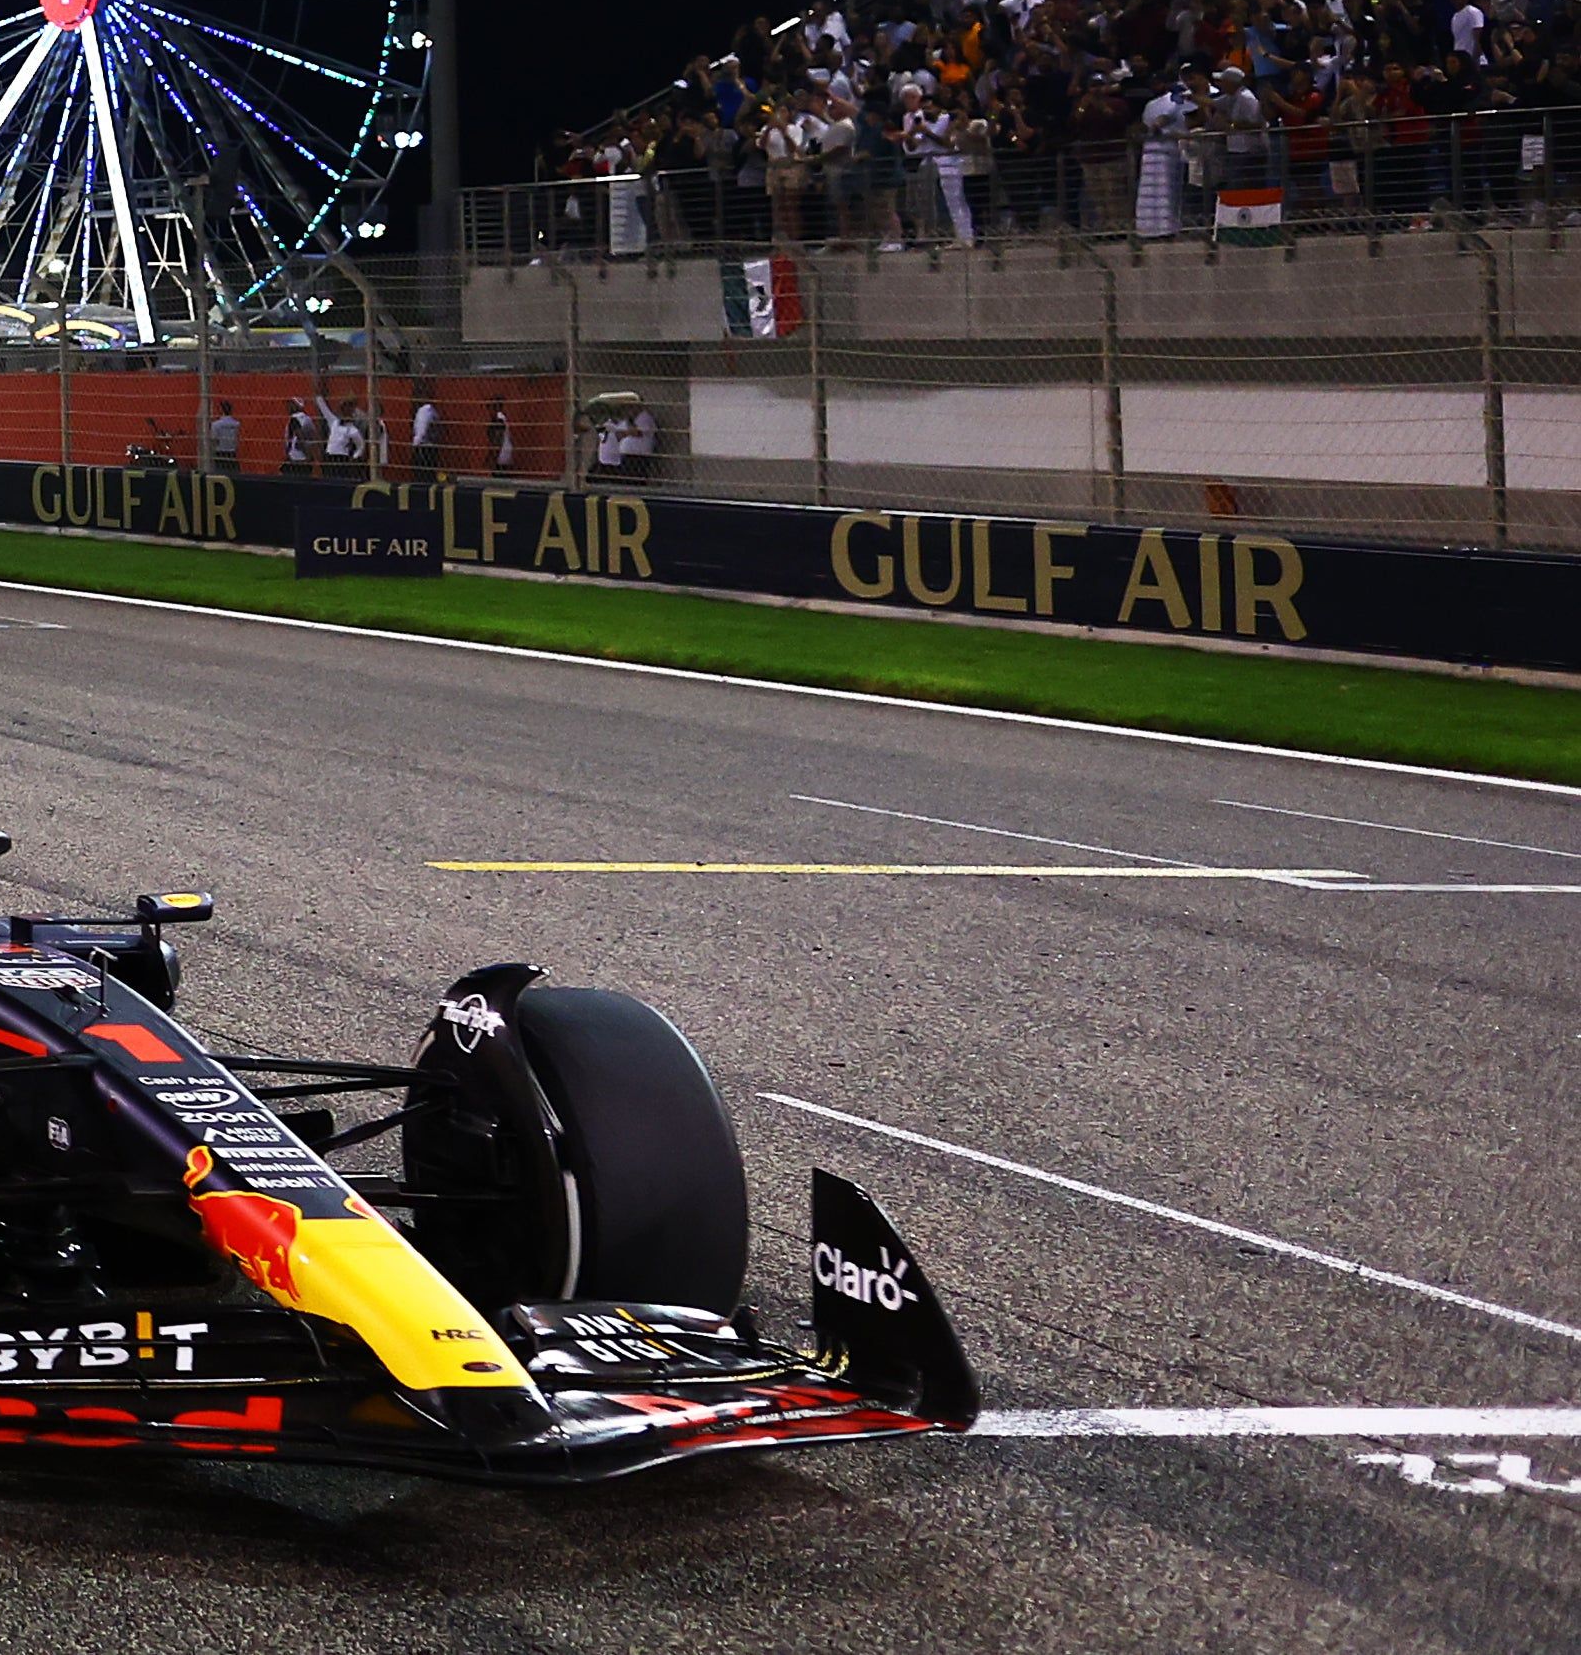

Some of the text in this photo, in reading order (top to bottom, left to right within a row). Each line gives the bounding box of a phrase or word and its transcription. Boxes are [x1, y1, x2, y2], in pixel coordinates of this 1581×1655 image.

[32, 463, 237, 540] GULF AIR
[312, 536, 429, 558] GULF AIR
[534, 490, 653, 578] AIR
[830, 510, 1307, 642] GULF AIR
[138, 1076, 226, 1087] Cash App
[174, 1111, 269, 1123] zoom
[245, 1177, 314, 1189] Mobil
[814, 1242, 904, 1311] Claro
